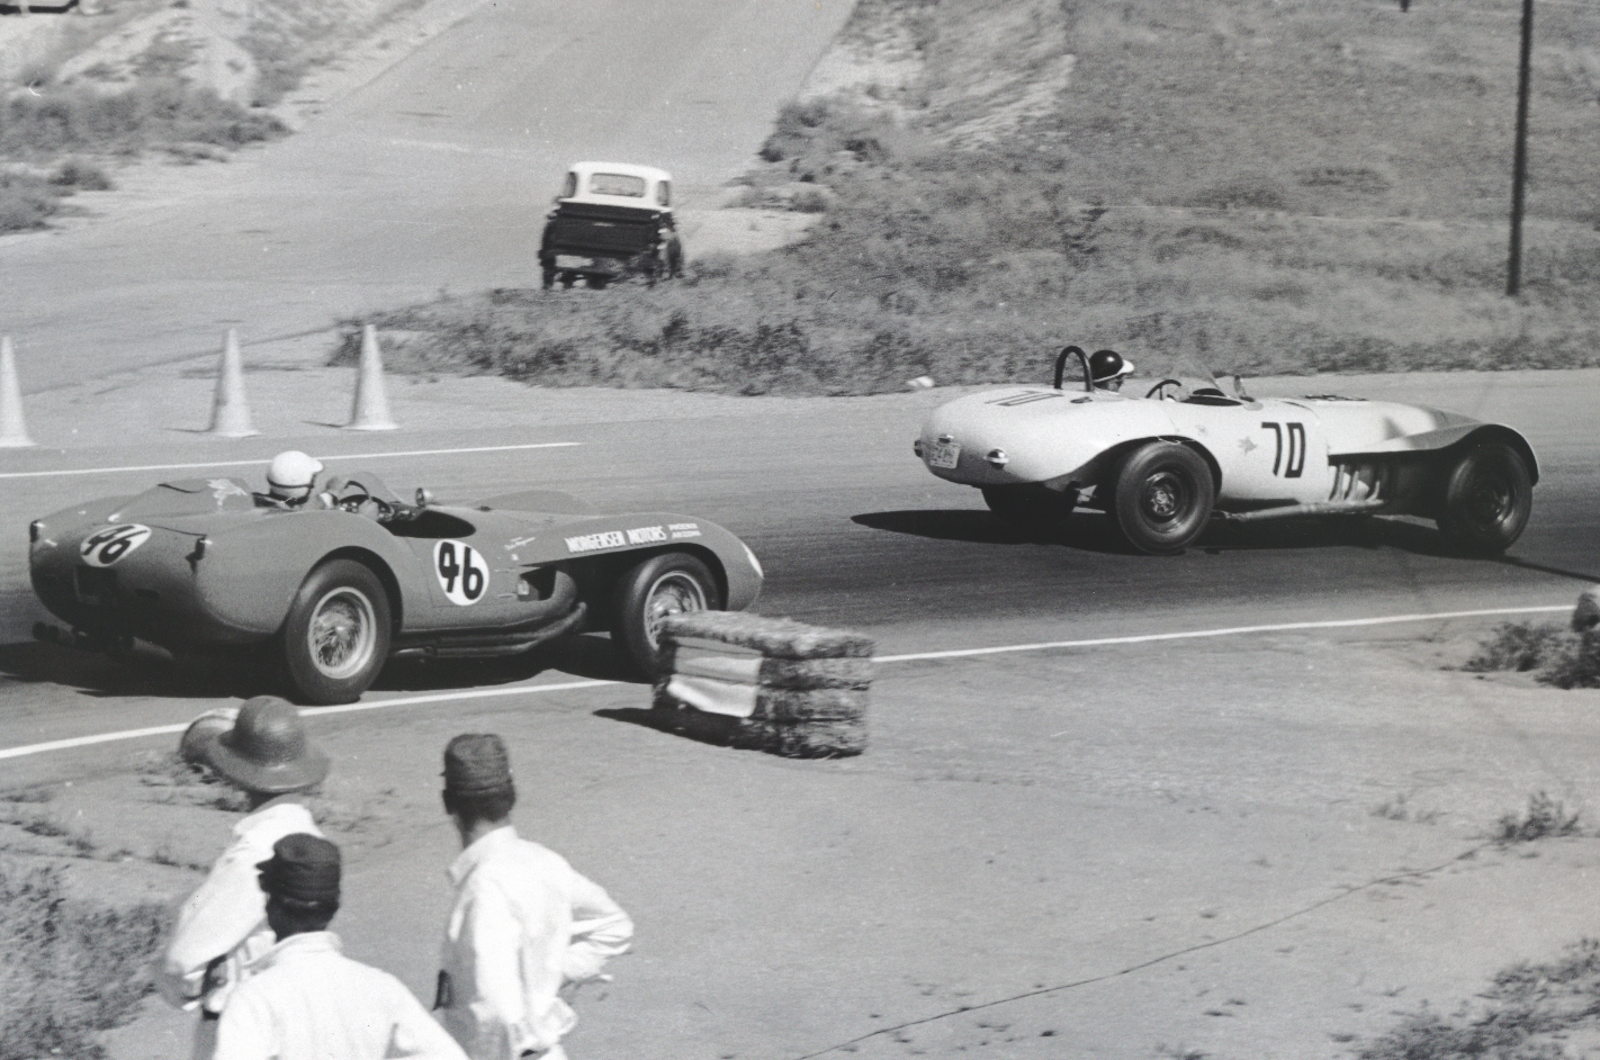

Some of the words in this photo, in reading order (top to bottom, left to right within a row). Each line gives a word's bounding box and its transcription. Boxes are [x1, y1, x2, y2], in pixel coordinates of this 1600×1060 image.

[1261, 421, 1306, 478] 70
[83, 525, 149, 564] 46
[626, 525, 668, 545] MOTORS
[439, 541, 484, 601] 46
